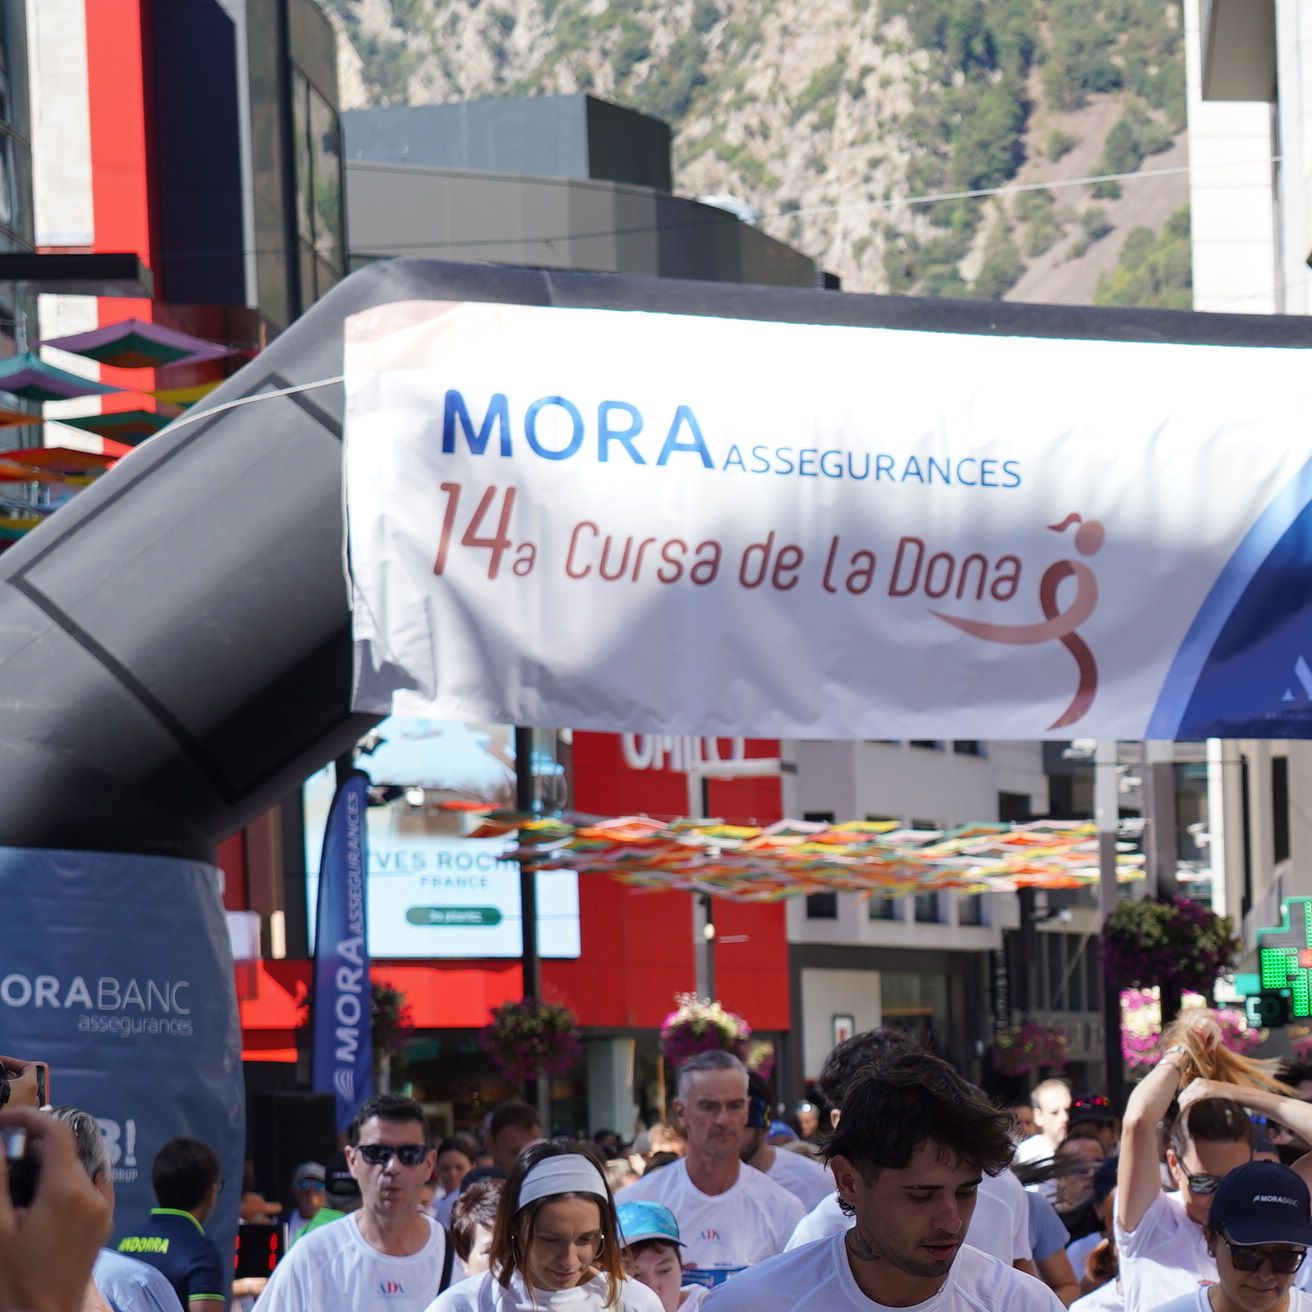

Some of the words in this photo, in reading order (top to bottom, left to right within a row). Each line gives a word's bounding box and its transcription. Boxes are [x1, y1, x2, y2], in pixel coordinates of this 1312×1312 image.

[442, 389, 715, 469] MORA
[723, 445, 1021, 488] ASSEGURANCES
[565, 521, 722, 585] Cursa
[739, 530, 804, 591] de
[822, 535, 877, 595] la
[888, 536, 1022, 601] Dona
[368, 850, 427, 871] VES
[438, 850, 520, 871] ROCH
[420, 876, 488, 888] FRANCE
[0, 974, 192, 1015] ORABANC
[334, 935, 365, 1063] MORA
[78, 1013, 193, 1038] assegurances
